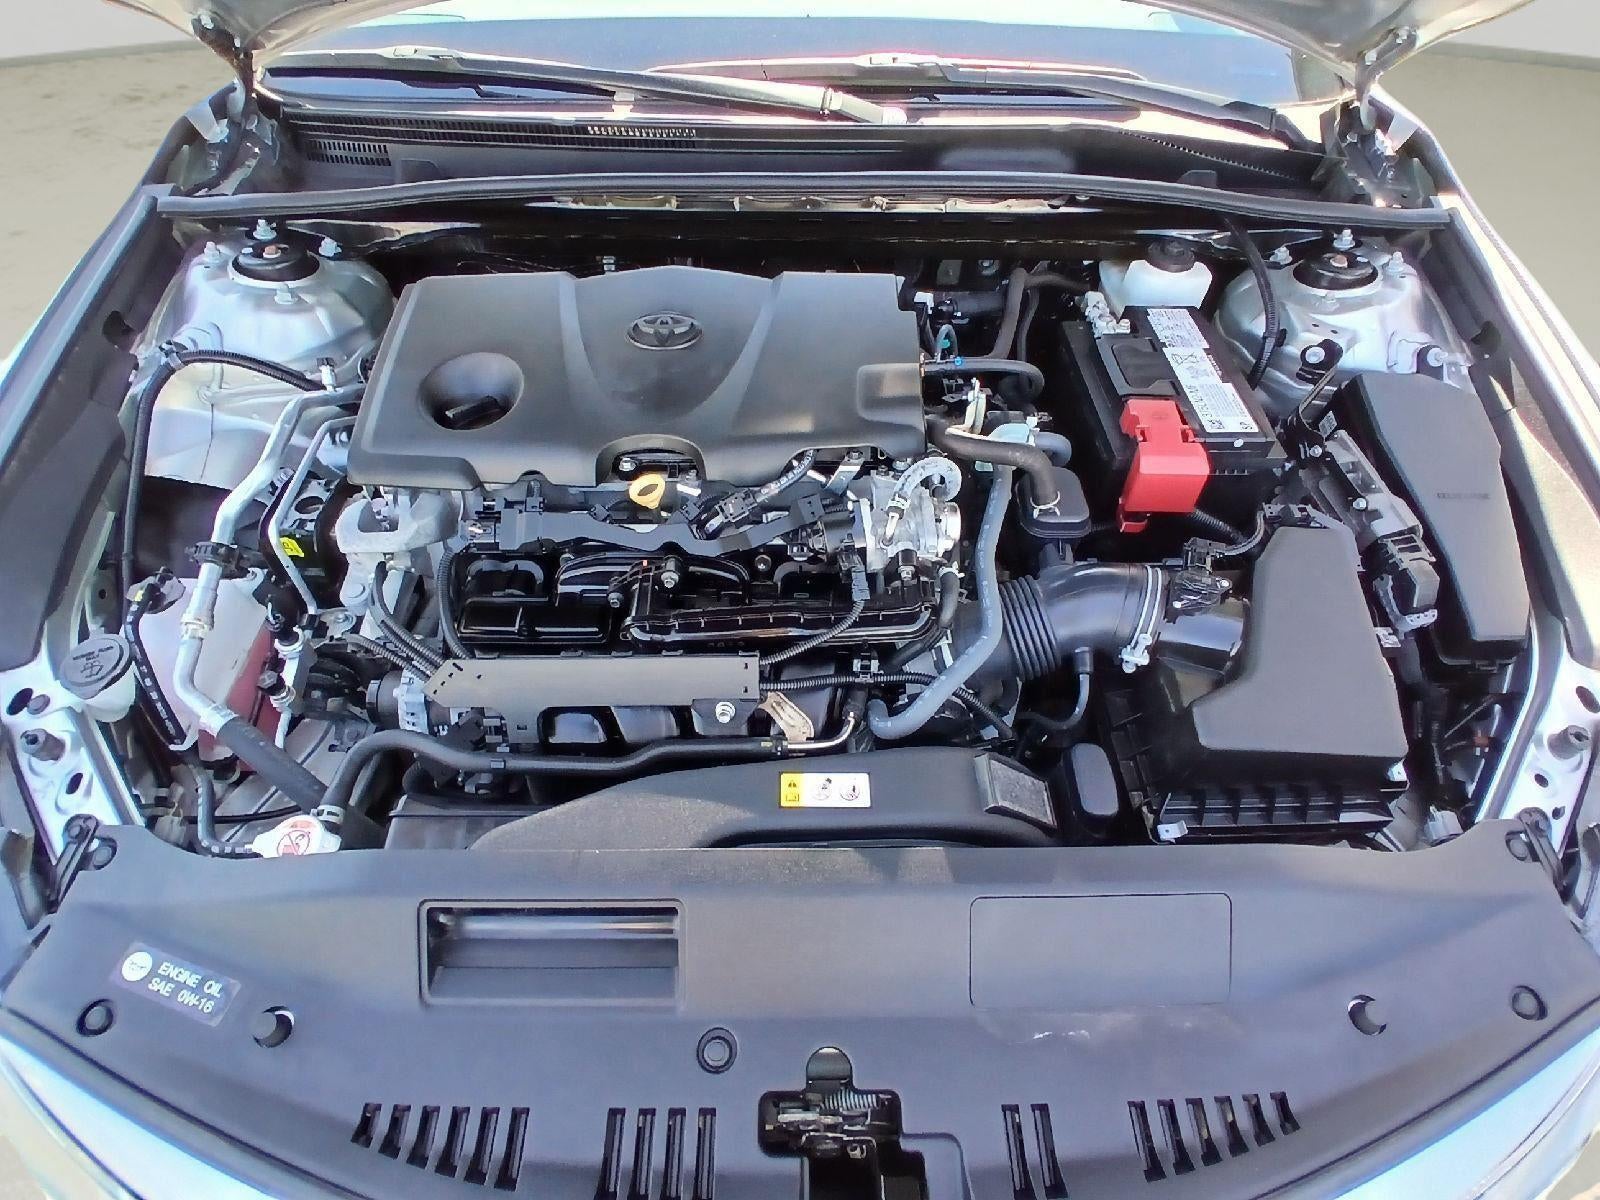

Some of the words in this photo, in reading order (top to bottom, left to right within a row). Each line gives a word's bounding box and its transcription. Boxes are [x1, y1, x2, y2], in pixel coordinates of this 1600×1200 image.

[147, 977, 176, 997] SAE
[177, 989, 215, 1013] 0W-16
[157, 961, 202, 988] ENGINE
[203, 980, 223, 998] OIL
